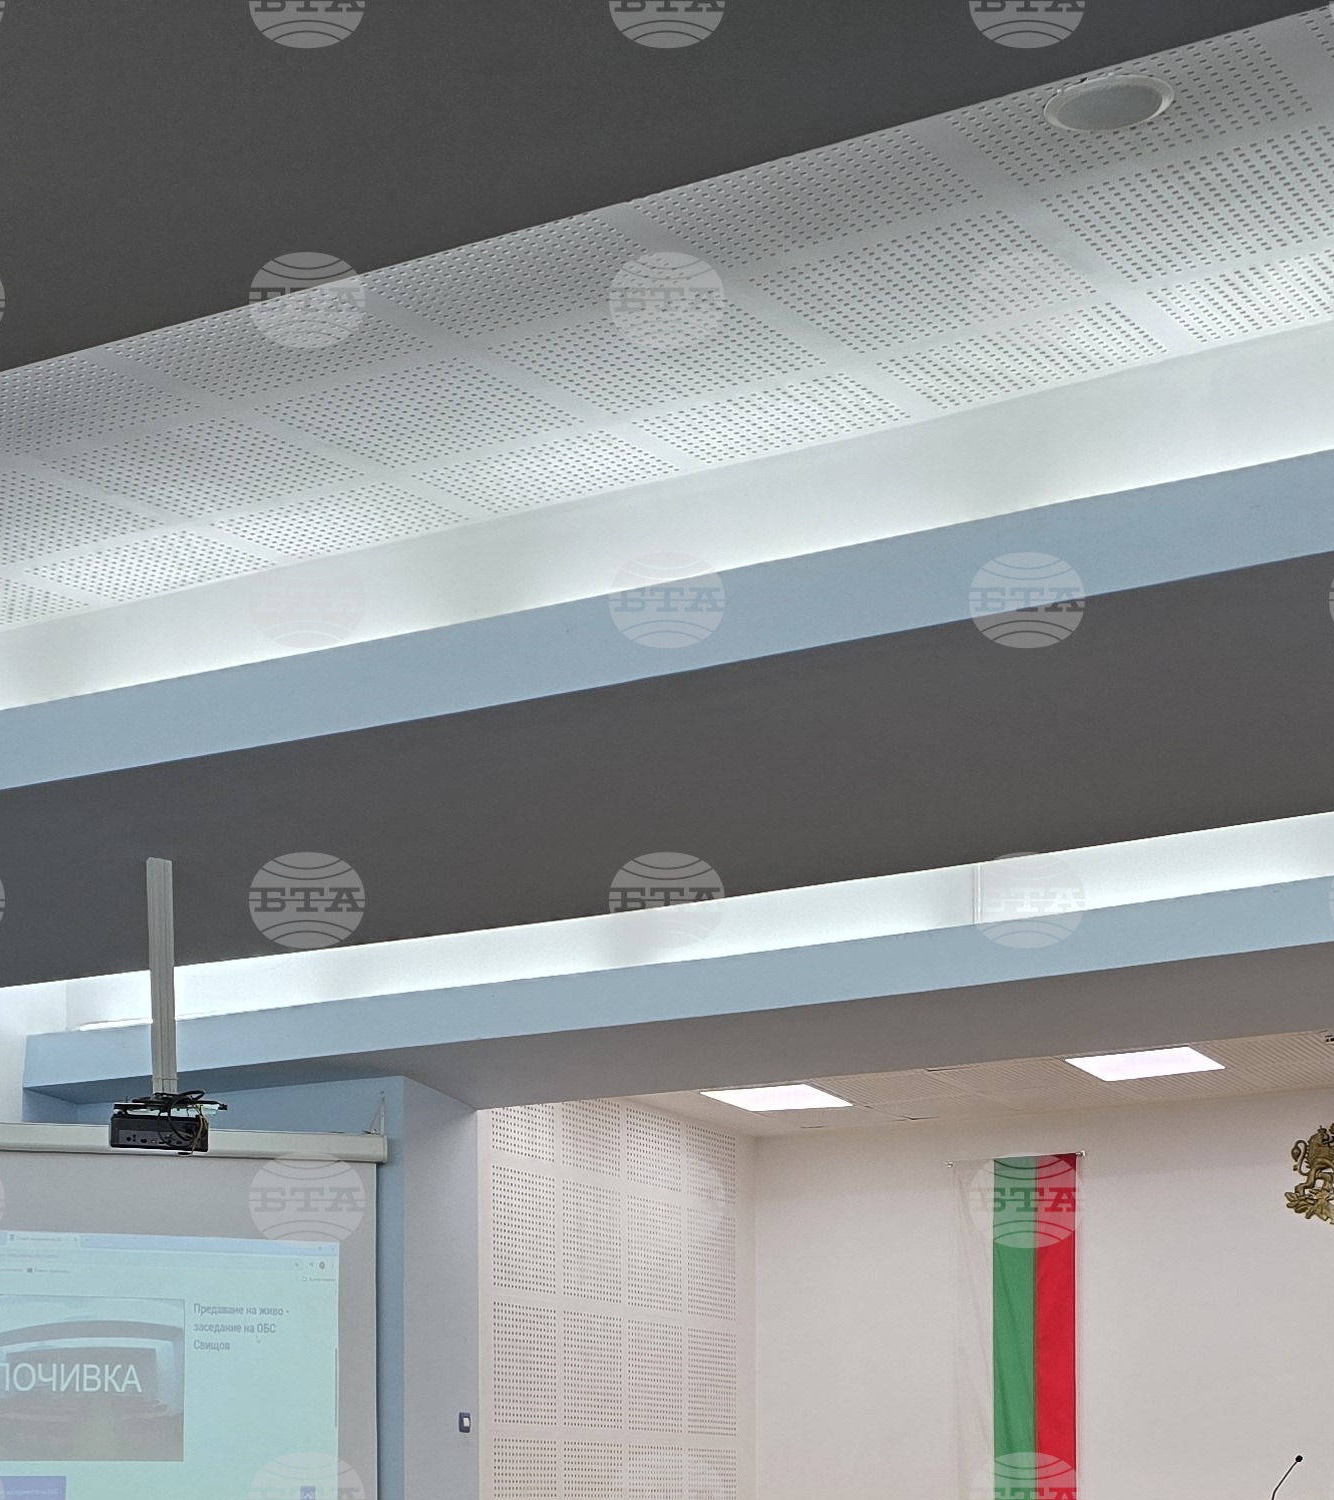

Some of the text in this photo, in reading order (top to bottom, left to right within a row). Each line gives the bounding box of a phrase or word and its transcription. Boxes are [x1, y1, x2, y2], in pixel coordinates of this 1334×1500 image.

[193, 1303, 245, 1316] Предаване
[246, 1307, 257, 1315] на
[259, 1307, 284, 1316] живо
[193, 1323, 276, 1334] заседание на ОБС
[193, 1340, 231, 1352] Свищов
